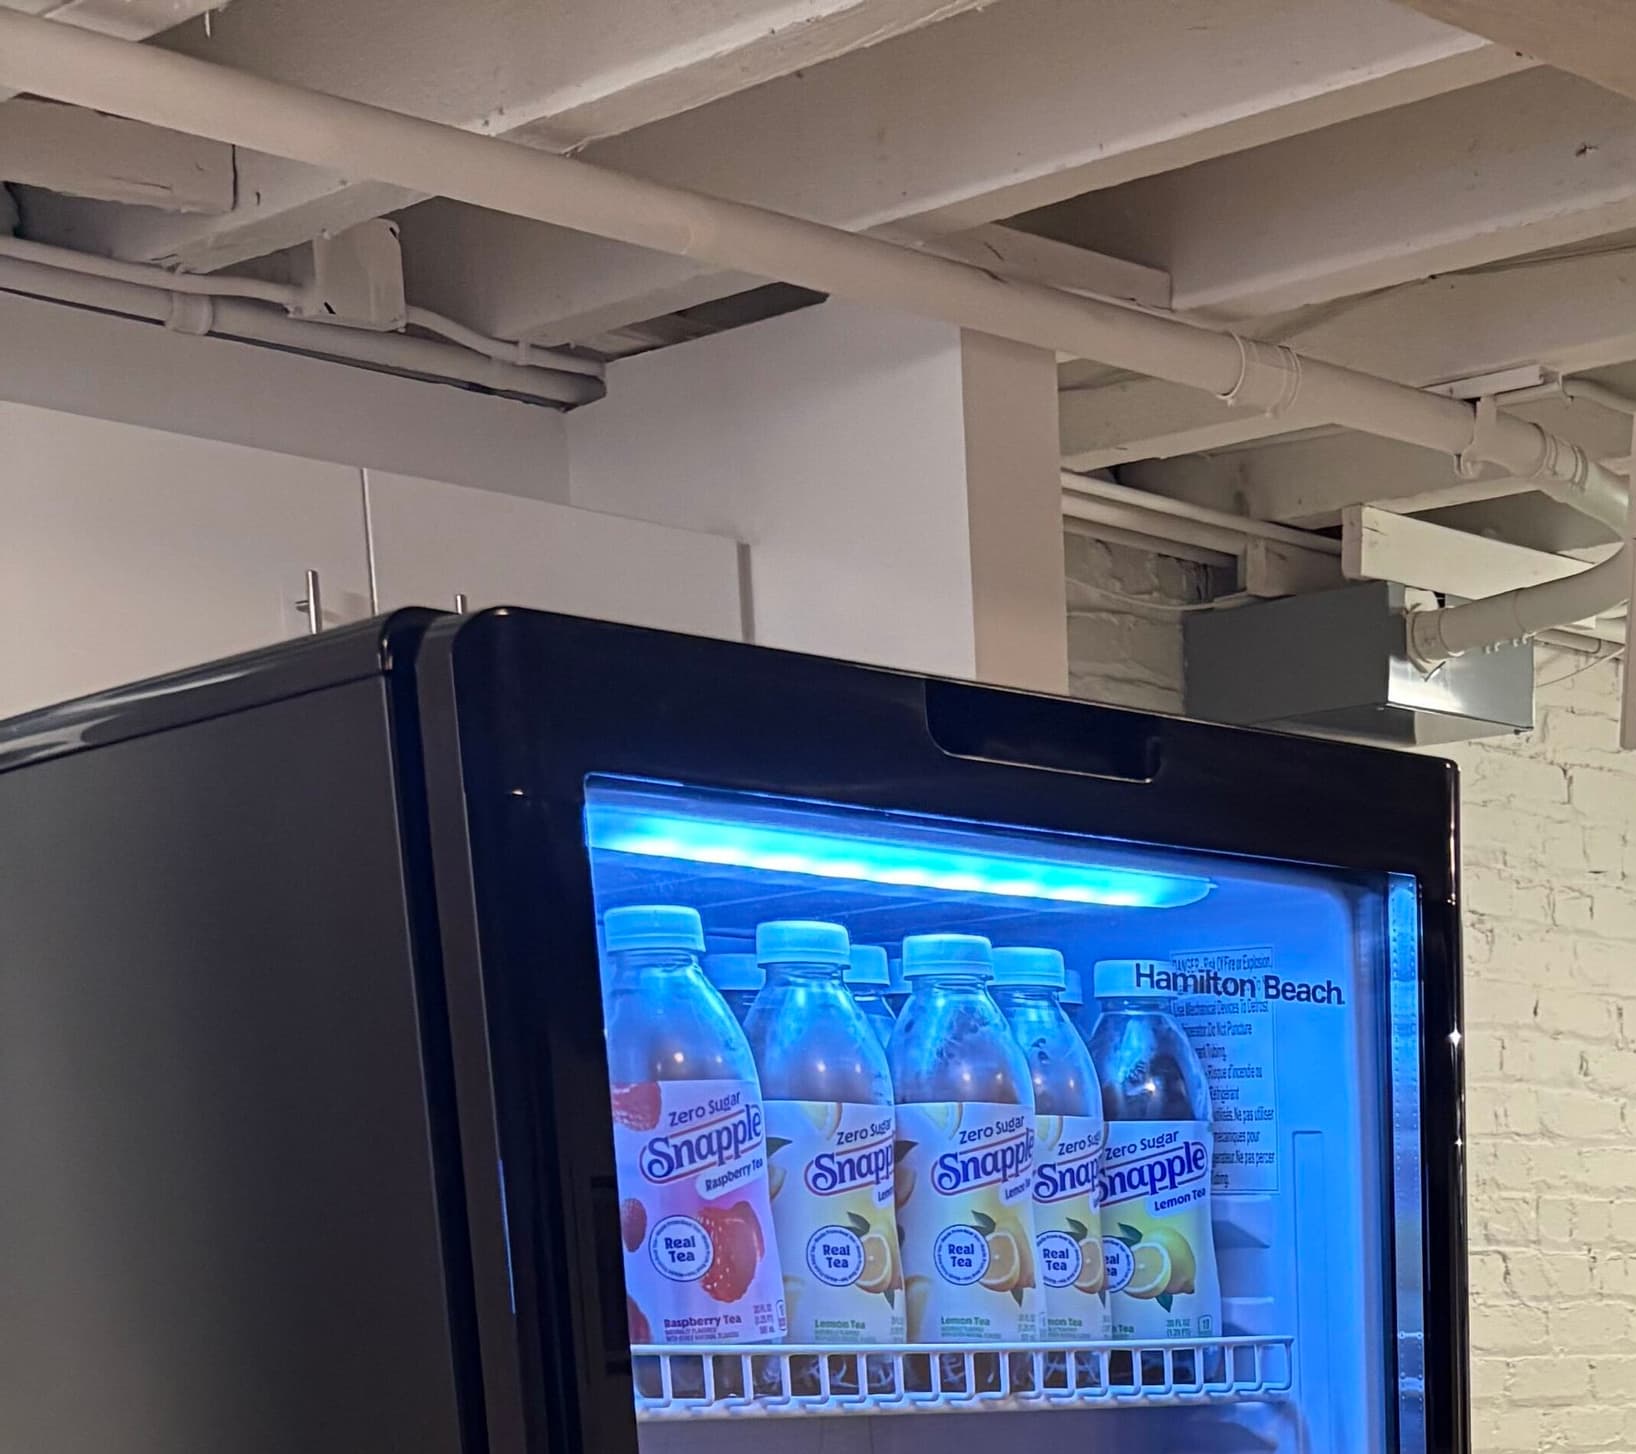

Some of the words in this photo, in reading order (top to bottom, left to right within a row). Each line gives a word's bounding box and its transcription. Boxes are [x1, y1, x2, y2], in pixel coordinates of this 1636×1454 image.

[1136, 963, 1255, 998] Hamilton
[669, 1104, 705, 1127] Zero
[708, 1091, 741, 1115] Sugar
[837, 1128, 868, 1146] Zero
[959, 1128, 994, 1145] Zero
[996, 1116, 1024, 1134] Sugar
[648, 1104, 762, 1179] Snapple
[1058, 1140, 1085, 1156] Zero
[1106, 1144, 1137, 1161] Zero
[1140, 1131, 1179, 1151] Sugar
[705, 1162, 752, 1192] Raspberry
[752, 1157, 763, 1174] Tea
[811, 1143, 894, 1192] Snapp
[1154, 1193, 1190, 1211] Lemon
[665, 1236, 697, 1250] Real
[823, 1245, 850, 1257] Real
[948, 1243, 975, 1255] Real
[668, 1250, 695, 1263] Tea
[950, 1256, 972, 1267] Tea
[1043, 1248, 1069, 1260] Real
[826, 1257, 849, 1269] Tea
[1045, 1260, 1067, 1271] Tea
[664, 1314, 721, 1329] Raspberry
[723, 1313, 742, 1325] Tea
[815, 1319, 849, 1329] Lemon
[851, 1320, 866, 1330] Tea
[941, 1316, 972, 1326] Lemon
[974, 1317, 990, 1326] Tea
